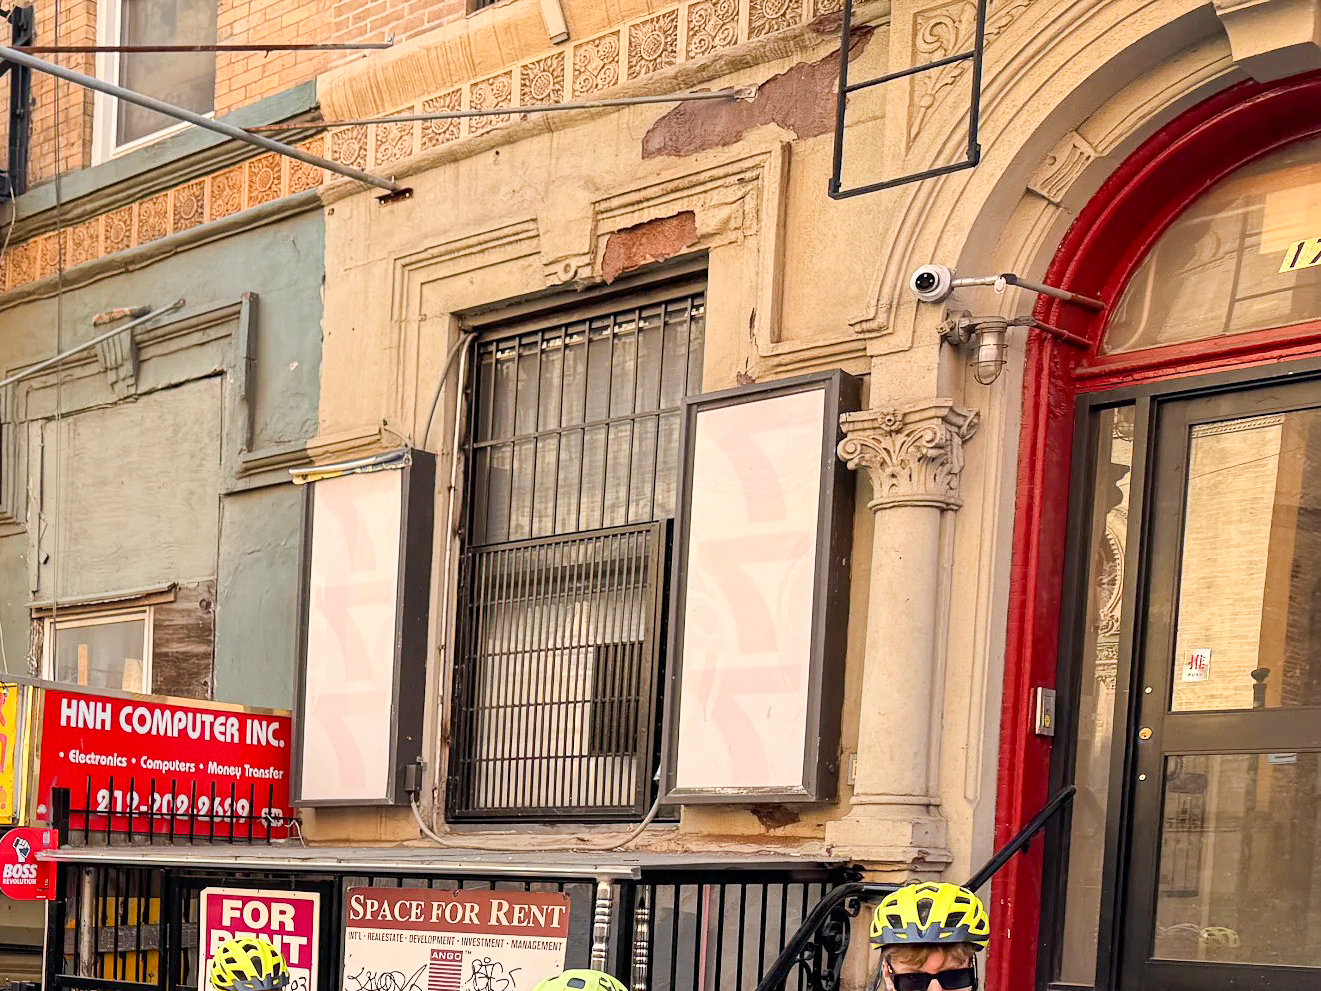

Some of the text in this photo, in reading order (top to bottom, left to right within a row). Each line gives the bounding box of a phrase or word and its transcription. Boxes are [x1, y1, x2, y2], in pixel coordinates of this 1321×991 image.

[60, 698, 286, 748] HNH COMPUTER INC.
[68, 749, 284, 780] Electronics Computers Money Transfer
[3, 863, 38, 879] BOSS
[221, 898, 295, 932] FOR
[349, 894, 566, 928] SPACE FOR RENT
[210, 928, 308, 964] RT
[367, 932, 404, 943] REALESTATE
[408, 934, 455, 945] DEVELOPMENT
[461, 938, 504, 948] INVESTMENT
[510, 940, 562, 951] MANAGEMENT
[431, 951, 462, 961] ANGO
